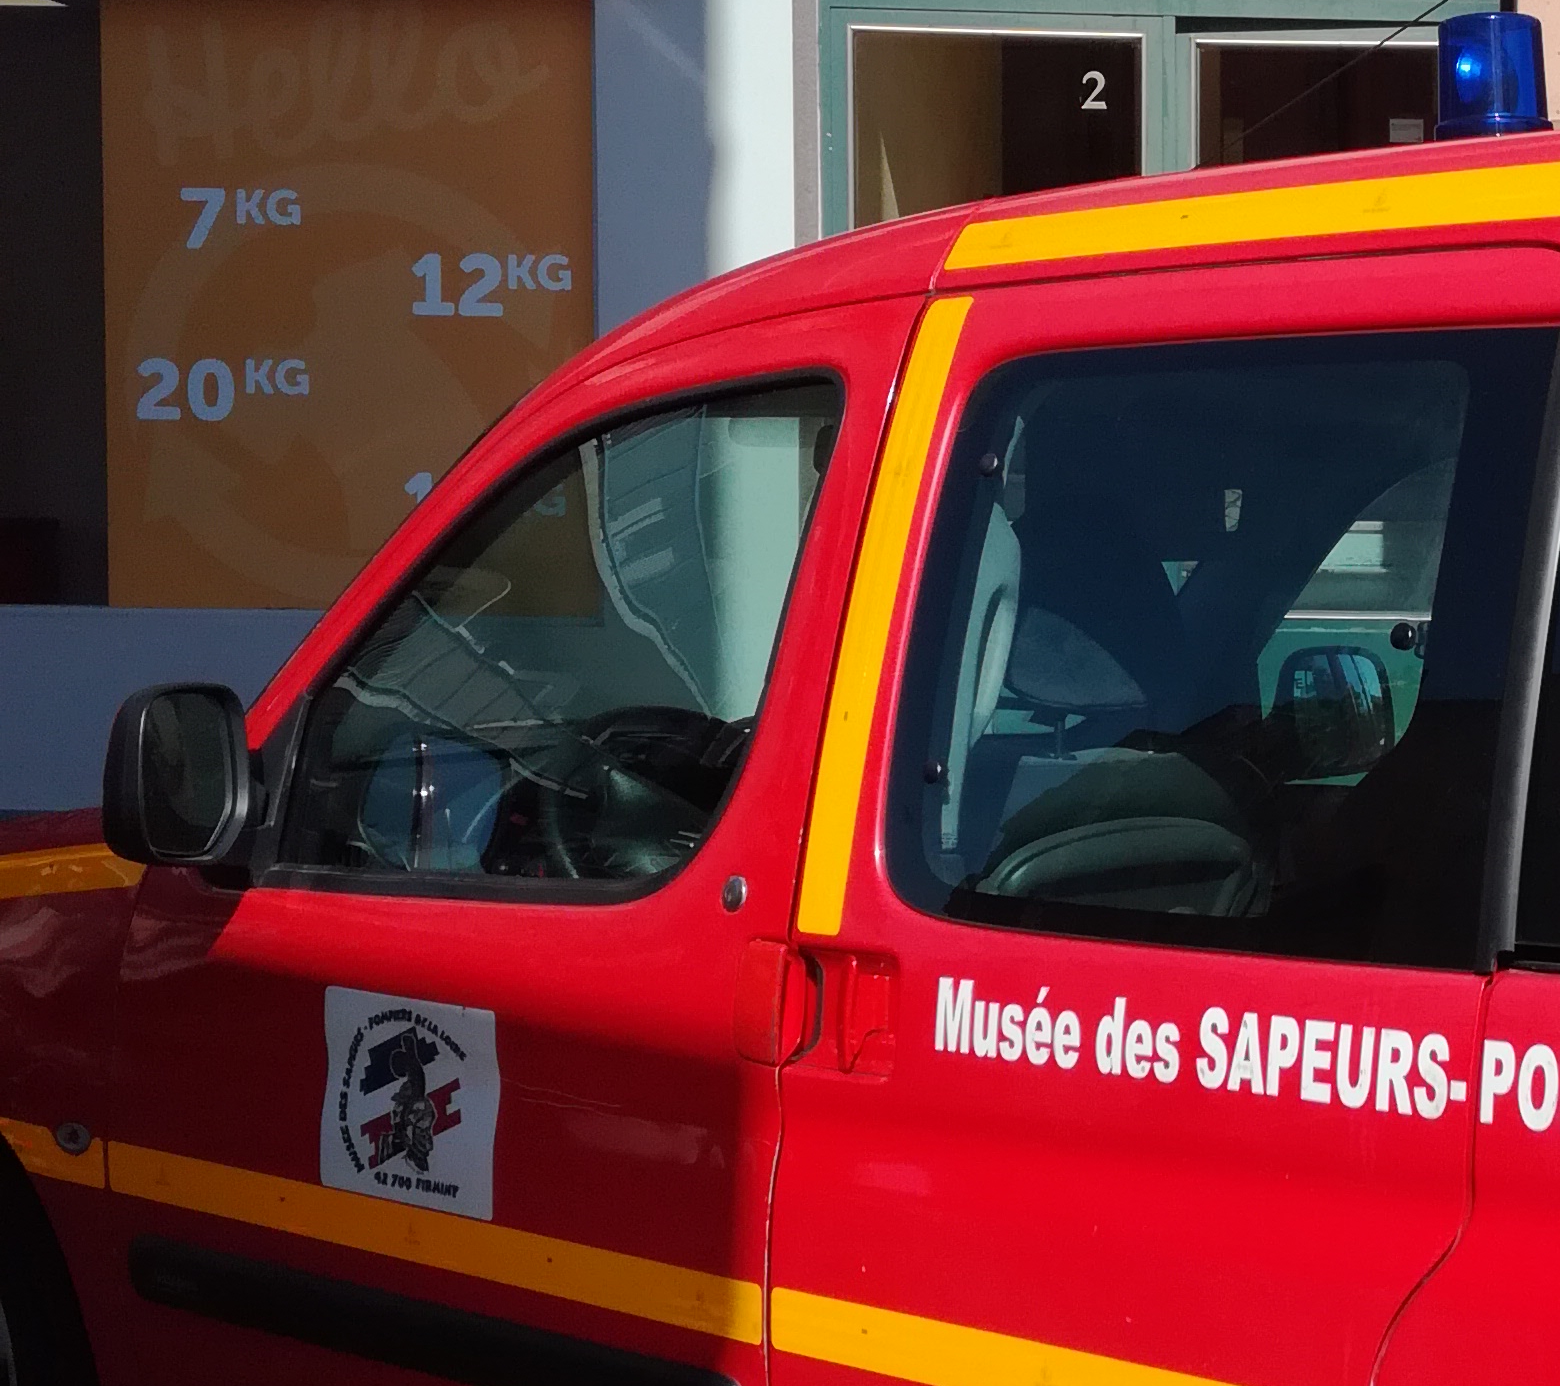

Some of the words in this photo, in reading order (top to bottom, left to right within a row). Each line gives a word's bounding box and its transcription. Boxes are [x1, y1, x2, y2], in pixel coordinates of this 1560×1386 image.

[140, 15, 551, 169] Hello
[1080, 70, 1108, 111] 2
[934, 976, 1081, 1070] Musée
[1095, 996, 1181, 1082] des
